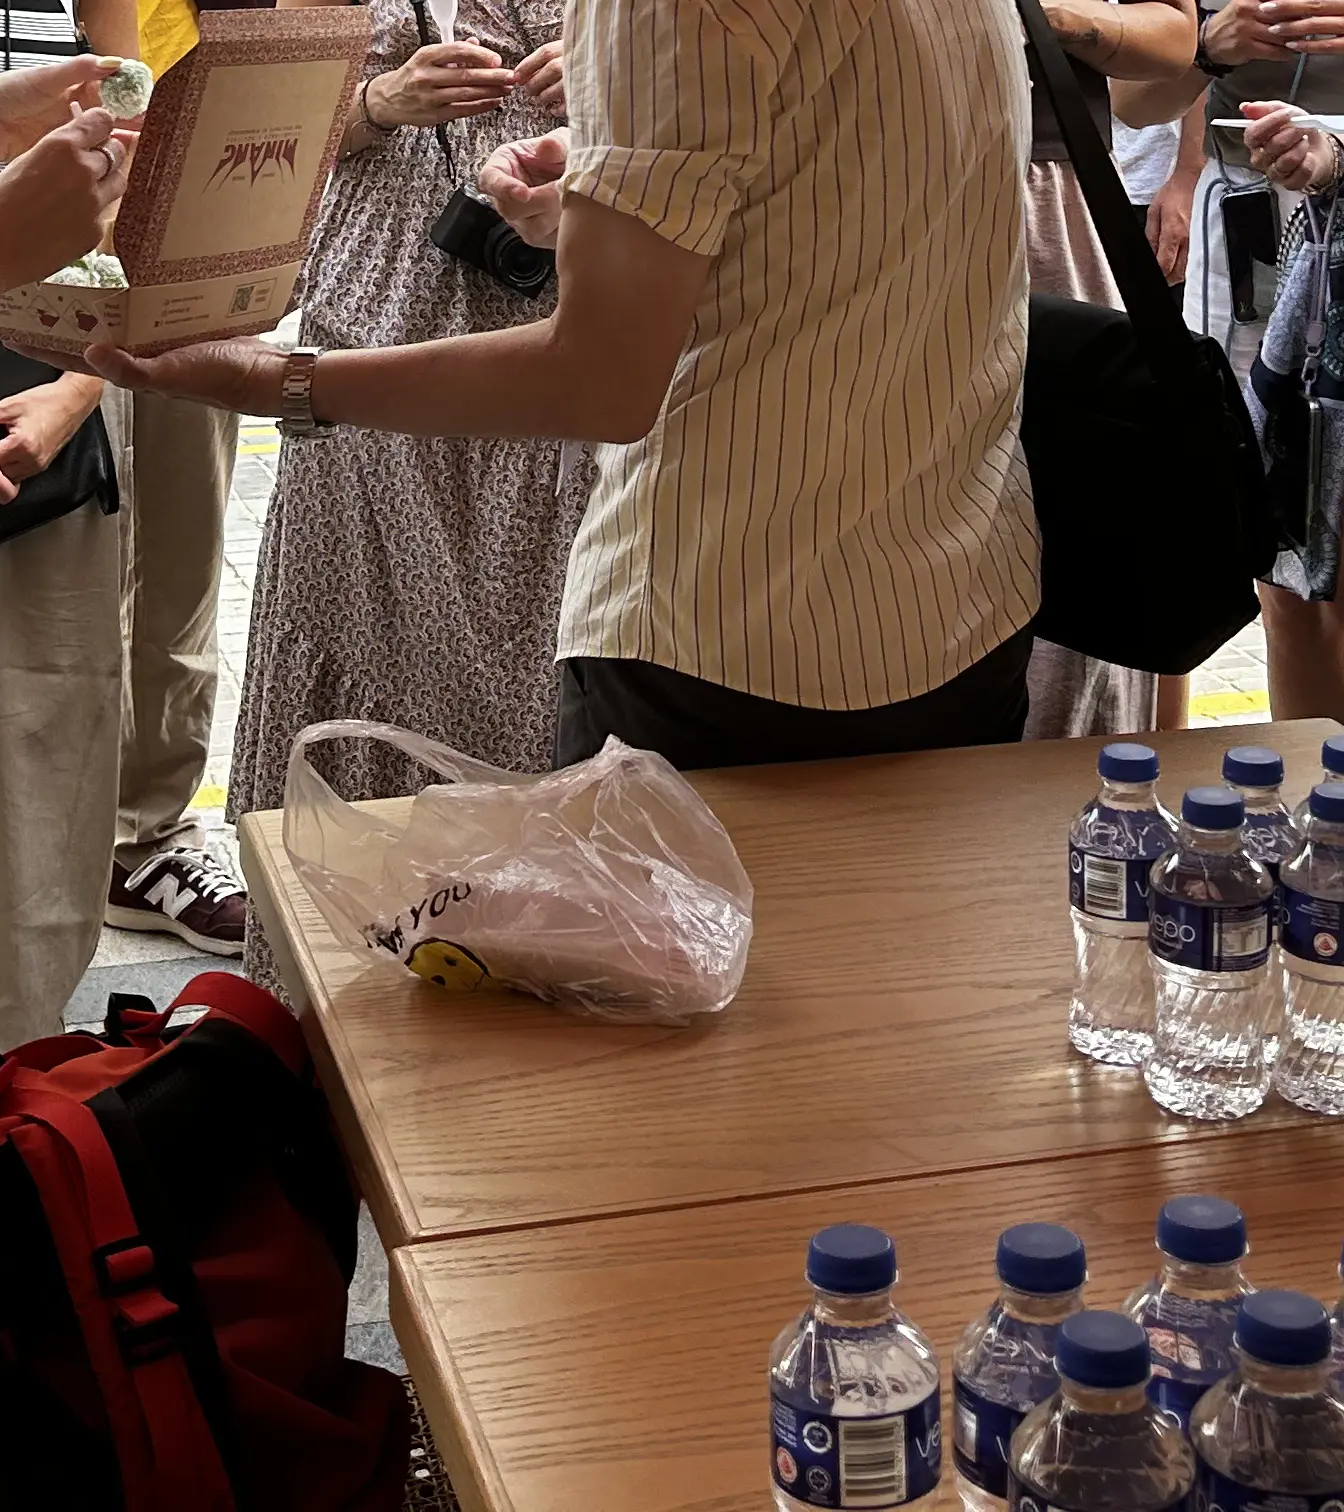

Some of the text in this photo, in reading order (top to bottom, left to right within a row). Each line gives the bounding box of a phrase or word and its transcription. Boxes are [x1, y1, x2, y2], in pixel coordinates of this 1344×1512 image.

[200, 138, 298, 196] MINANG
[143, 872, 199, 920] N
[409, 881, 473, 930] YOU
